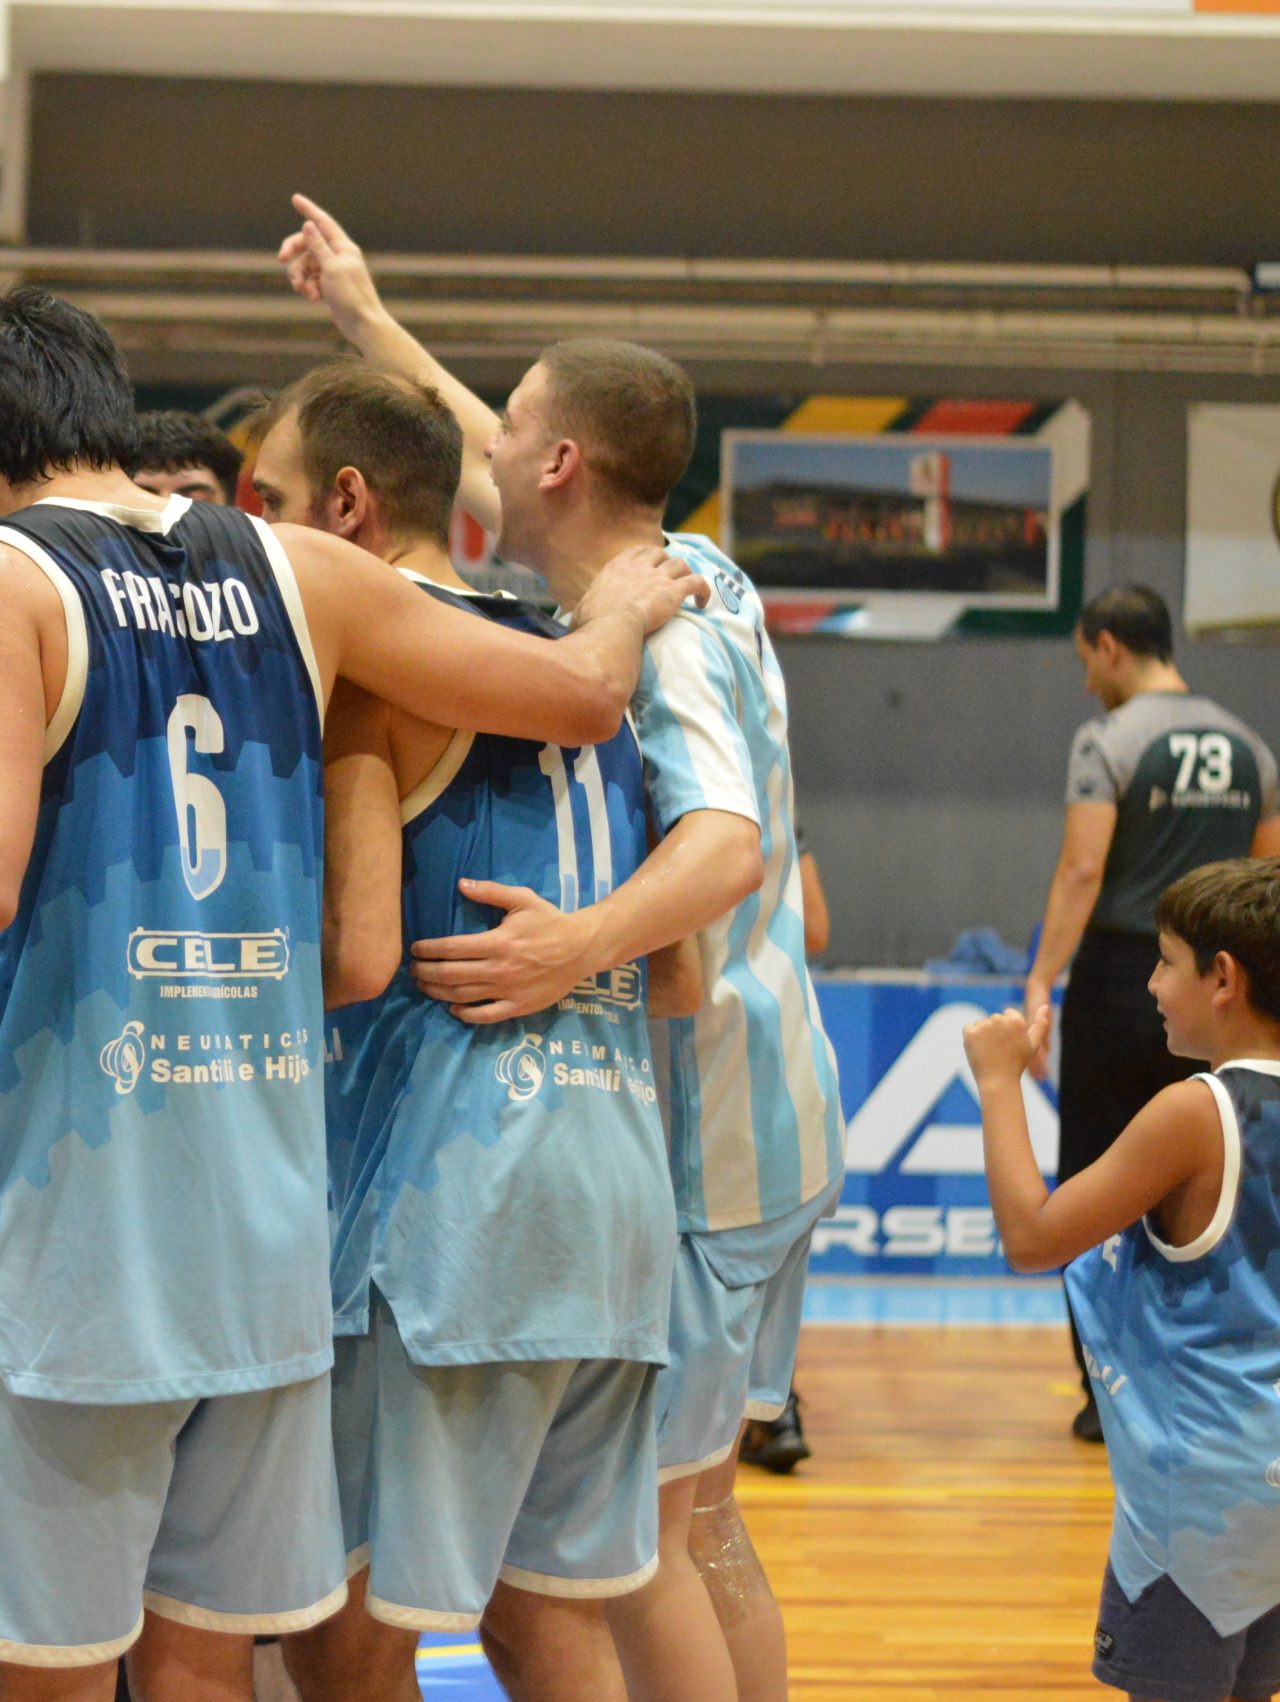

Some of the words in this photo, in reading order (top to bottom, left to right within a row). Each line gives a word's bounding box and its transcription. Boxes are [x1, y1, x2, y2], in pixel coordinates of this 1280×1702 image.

[167, 693, 227, 901] 6
[1169, 732, 1232, 794] 73
[538, 742, 613, 913] 11
[136, 937, 282, 971] CELE
